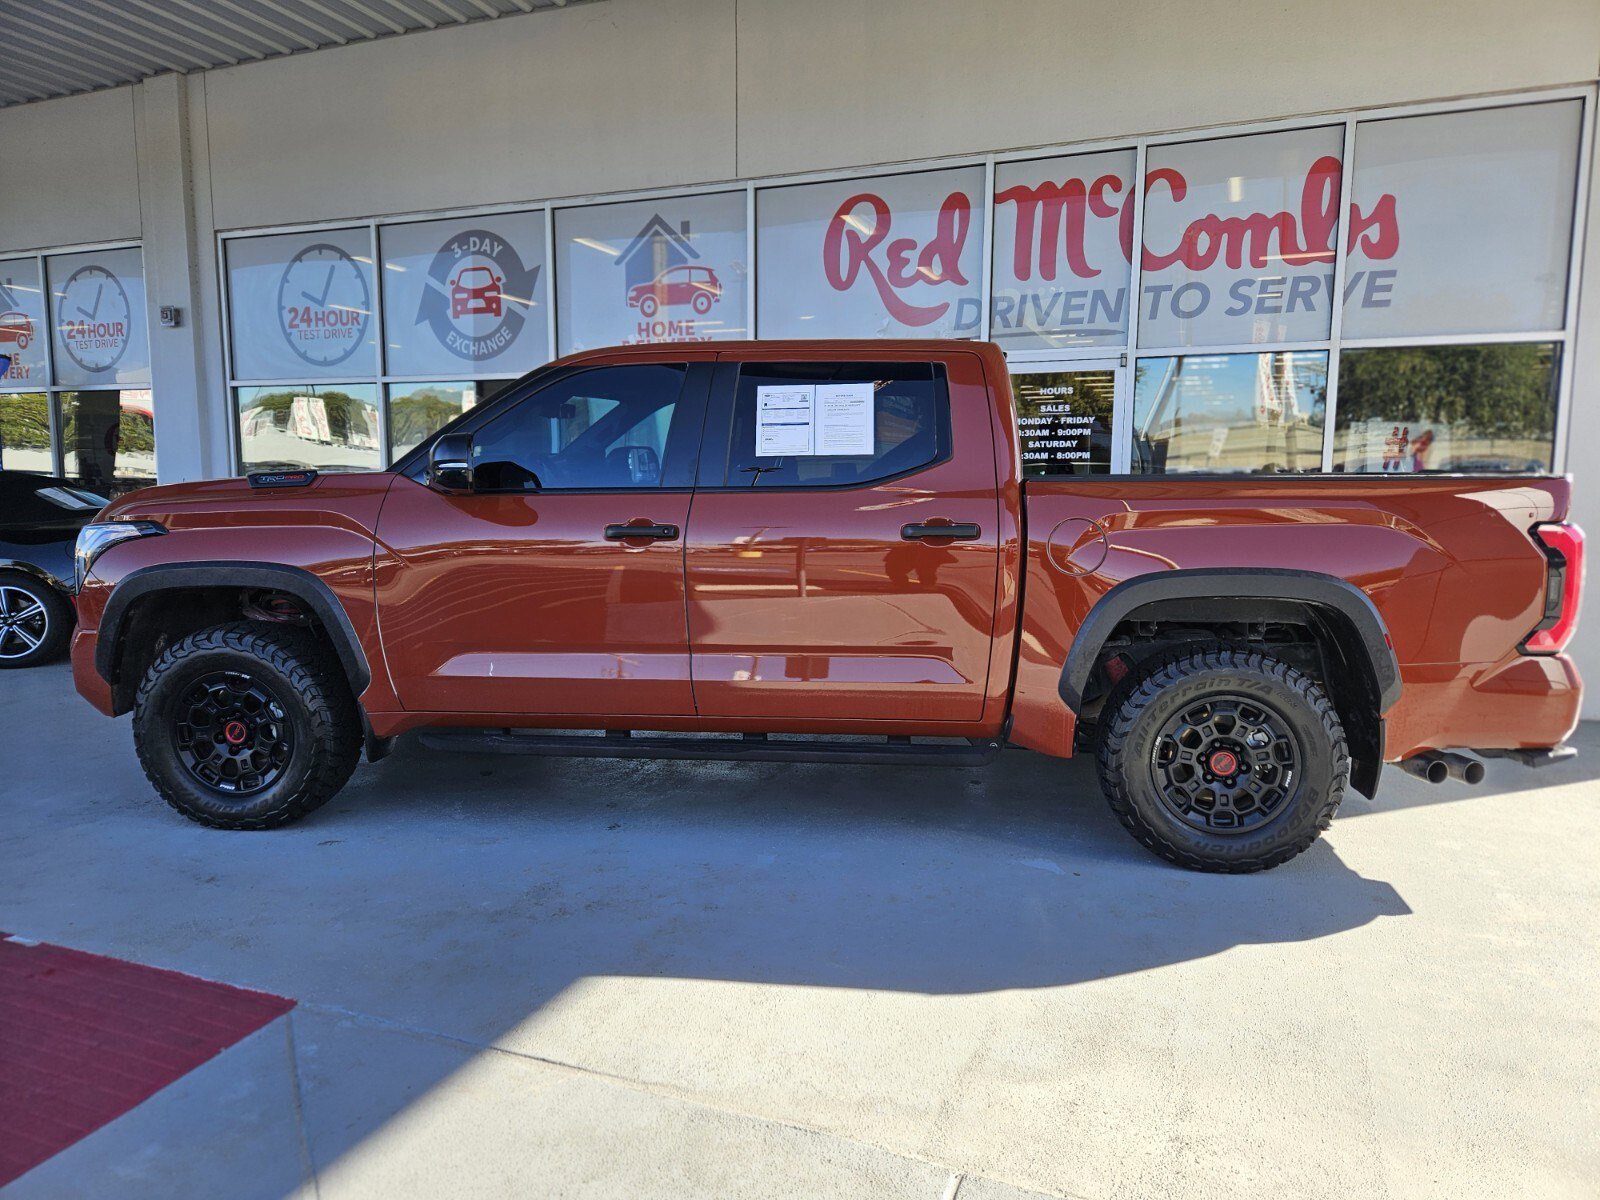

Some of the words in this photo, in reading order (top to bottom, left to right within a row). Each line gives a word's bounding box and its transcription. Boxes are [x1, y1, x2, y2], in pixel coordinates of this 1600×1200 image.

[451, 236, 503, 258] 3-DAY
[823, 191, 970, 327] Red
[993, 156, 1399, 281] McCombs
[954, 287, 1126, 331] DRIVEN
[1144, 282, 1211, 321] TO
[1224, 269, 1397, 317] SERVE
[287, 306, 312, 329] 24
[314, 309, 361, 327] HOUR
[66, 320, 87, 339] 24
[87, 322, 124, 339] HOUR
[297, 329, 321, 340] TEST
[323, 328, 354, 339] DRIVE
[637, 319, 695, 338] HOME
[74, 340, 93, 350] TEST
[95, 338, 119, 348] DRIVE
[446, 326, 512, 355] EXCHANGE
[1040, 386, 1074, 395] HOURS
[1040, 404, 1071, 413] SALES
[1061, 416, 1095, 424] FRIDAY
[1057, 428, 1091, 436] 9:00PM
[1028, 440, 1078, 448] SATURDAY
[1056, 451, 1090, 459] 8:00PM
[1134, 677, 1232, 758] All-Terrain
[1237, 677, 1274, 696] T/A
